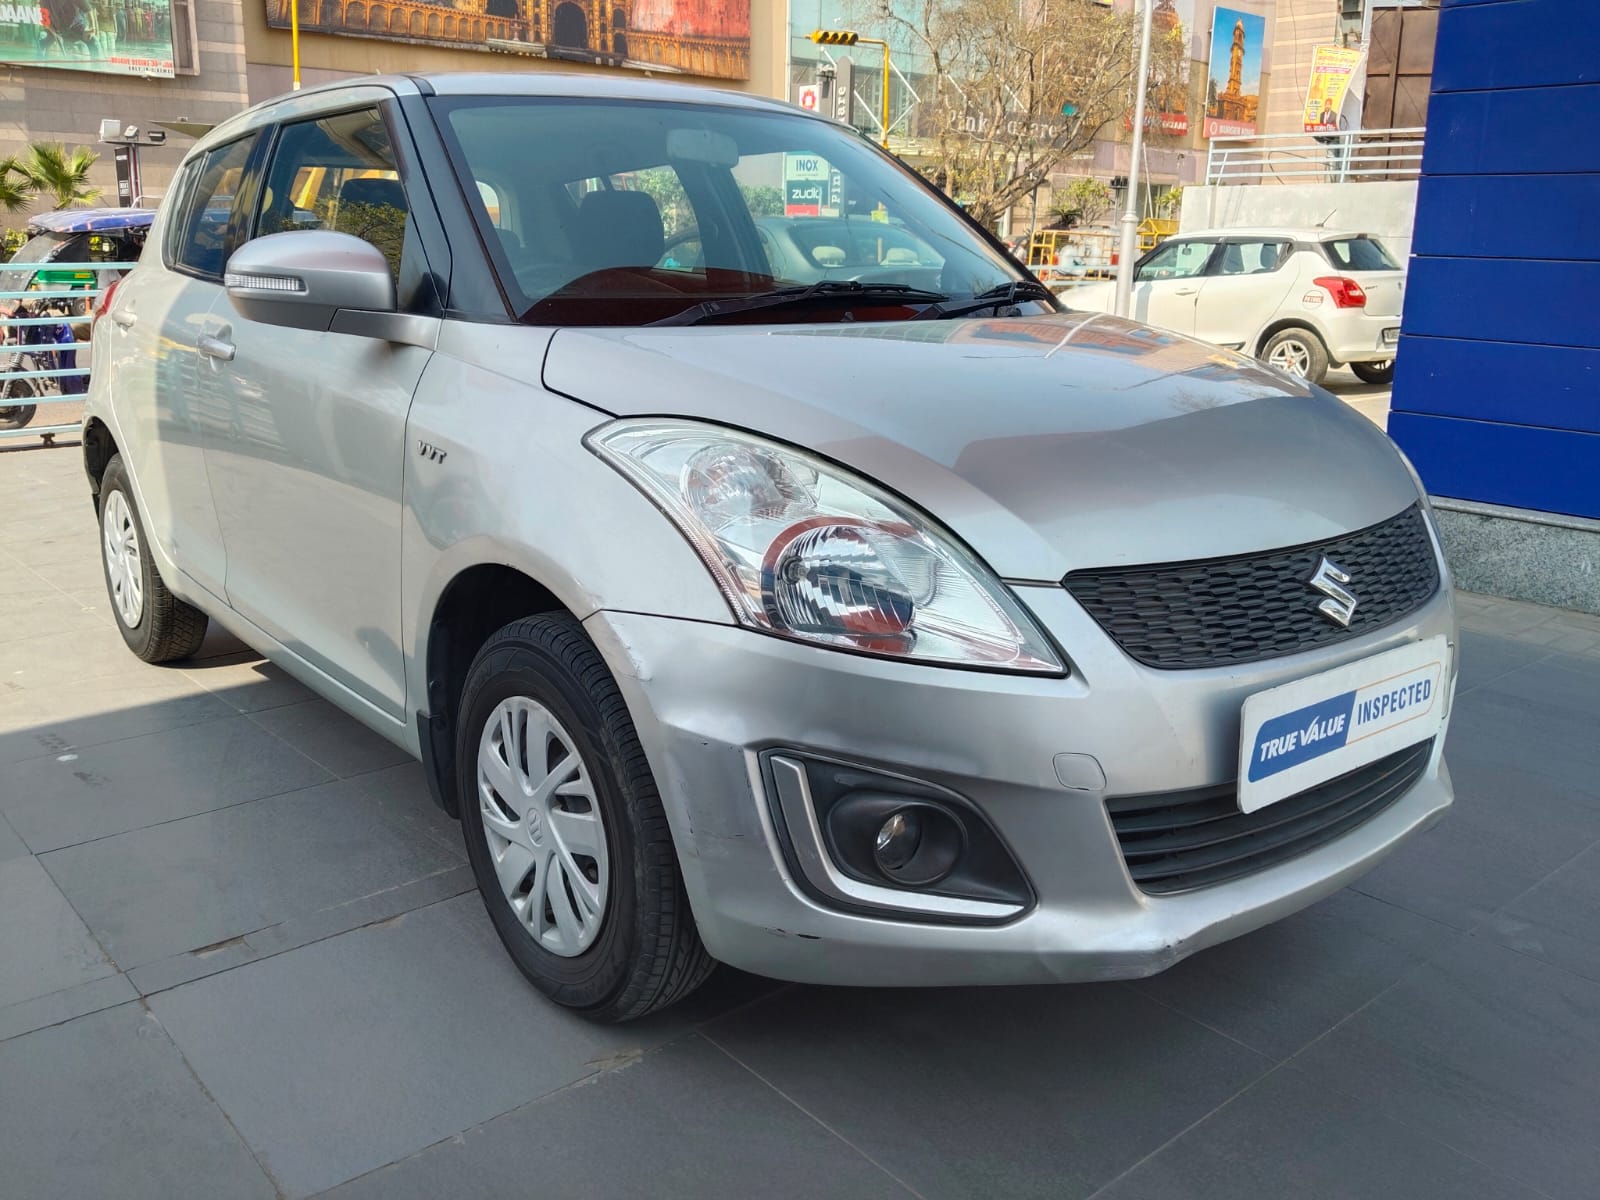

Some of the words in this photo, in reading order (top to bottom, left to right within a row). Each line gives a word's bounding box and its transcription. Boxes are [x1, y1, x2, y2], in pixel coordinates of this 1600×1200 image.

[993, 115, 1058, 139] quare
[796, 160, 818, 172] INOX
[1259, 731, 1299, 762] TRUE
[1300, 714, 1346, 747] VALUE
[1357, 678, 1432, 726] INSPECTED
